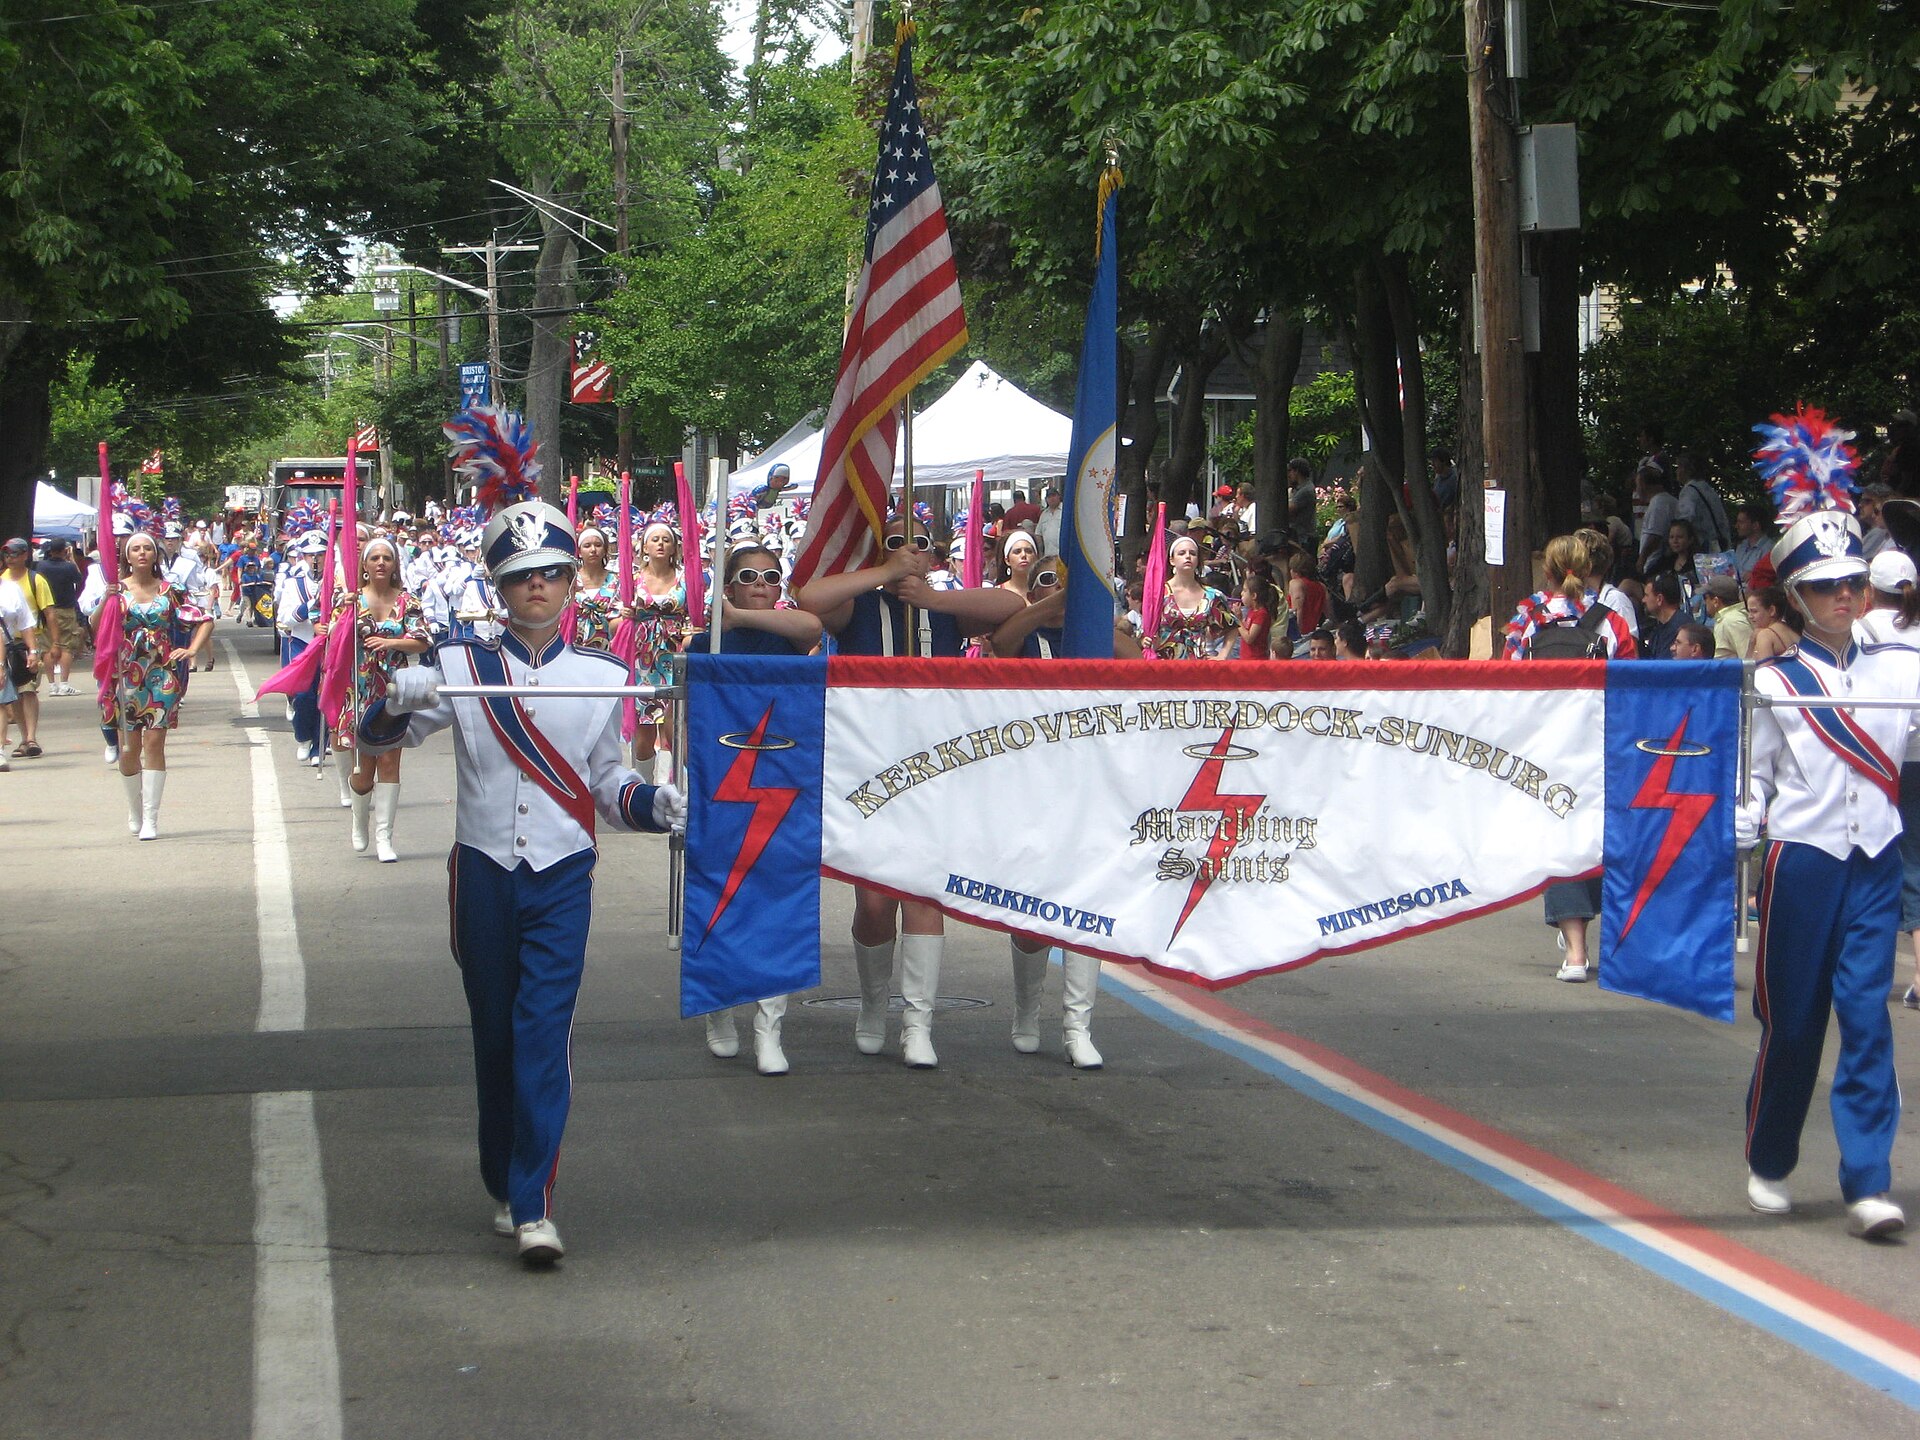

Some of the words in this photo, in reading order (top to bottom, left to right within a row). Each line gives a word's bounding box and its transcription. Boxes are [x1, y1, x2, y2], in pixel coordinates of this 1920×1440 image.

[462, 366, 485, 375] BRISTOL
[846, 699, 1577, 819] KERKHOVEN-MURDOCK-SUNBURG
[1130, 806, 1318, 849] Marching
[1156, 847, 1290, 883] Saints
[945, 873, 1116, 937] KERKHOVEN
[1317, 878, 1472, 936] MINNESOTA
